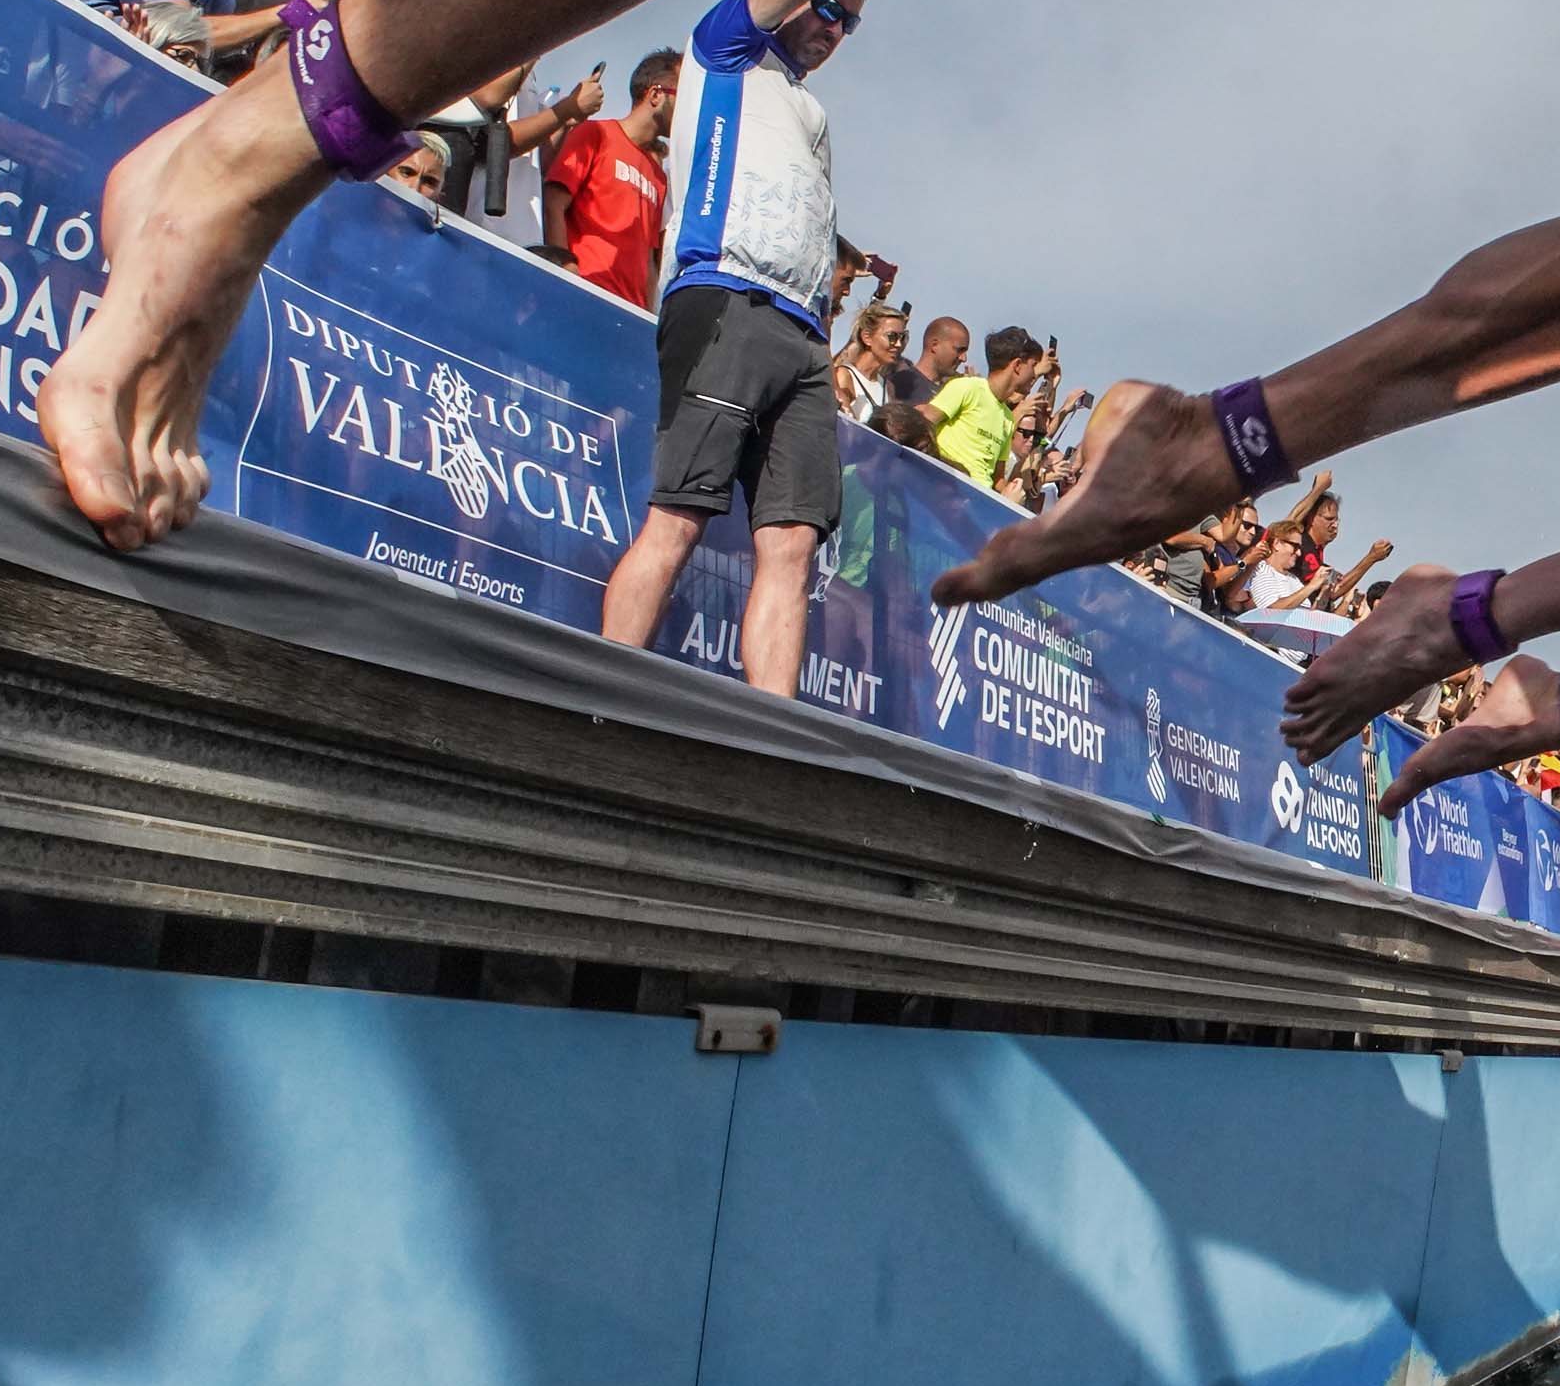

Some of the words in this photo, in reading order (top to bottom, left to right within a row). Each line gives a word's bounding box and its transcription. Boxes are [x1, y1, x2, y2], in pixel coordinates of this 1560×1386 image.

[708, 116, 727, 181] extraordinary
[700, 203, 712, 216] Be
[705, 181, 716, 203] your
[548, 419, 603, 467] DE
[365, 530, 447, 581] Joventut
[449, 559, 459, 583] i
[459, 562, 526, 605] Esports
[680, 611, 883, 715] AJUMENT
[1038, 620, 1093, 668] Valenciana
[974, 626, 1093, 714] COMUNITAT
[982, 679, 1011, 730] DE
[1016, 693, 1106, 764] L'ESPORT
[1167, 722, 1241, 773] GENERALITAT
[1169, 755, 1241, 804] VALENCIANA
[1306, 786, 1360, 831] TRINIDAD
[1439, 791, 1469, 827] World
[1306, 819, 1362, 860] ALFONSO
[1441, 824, 1483, 862] Triathlon
